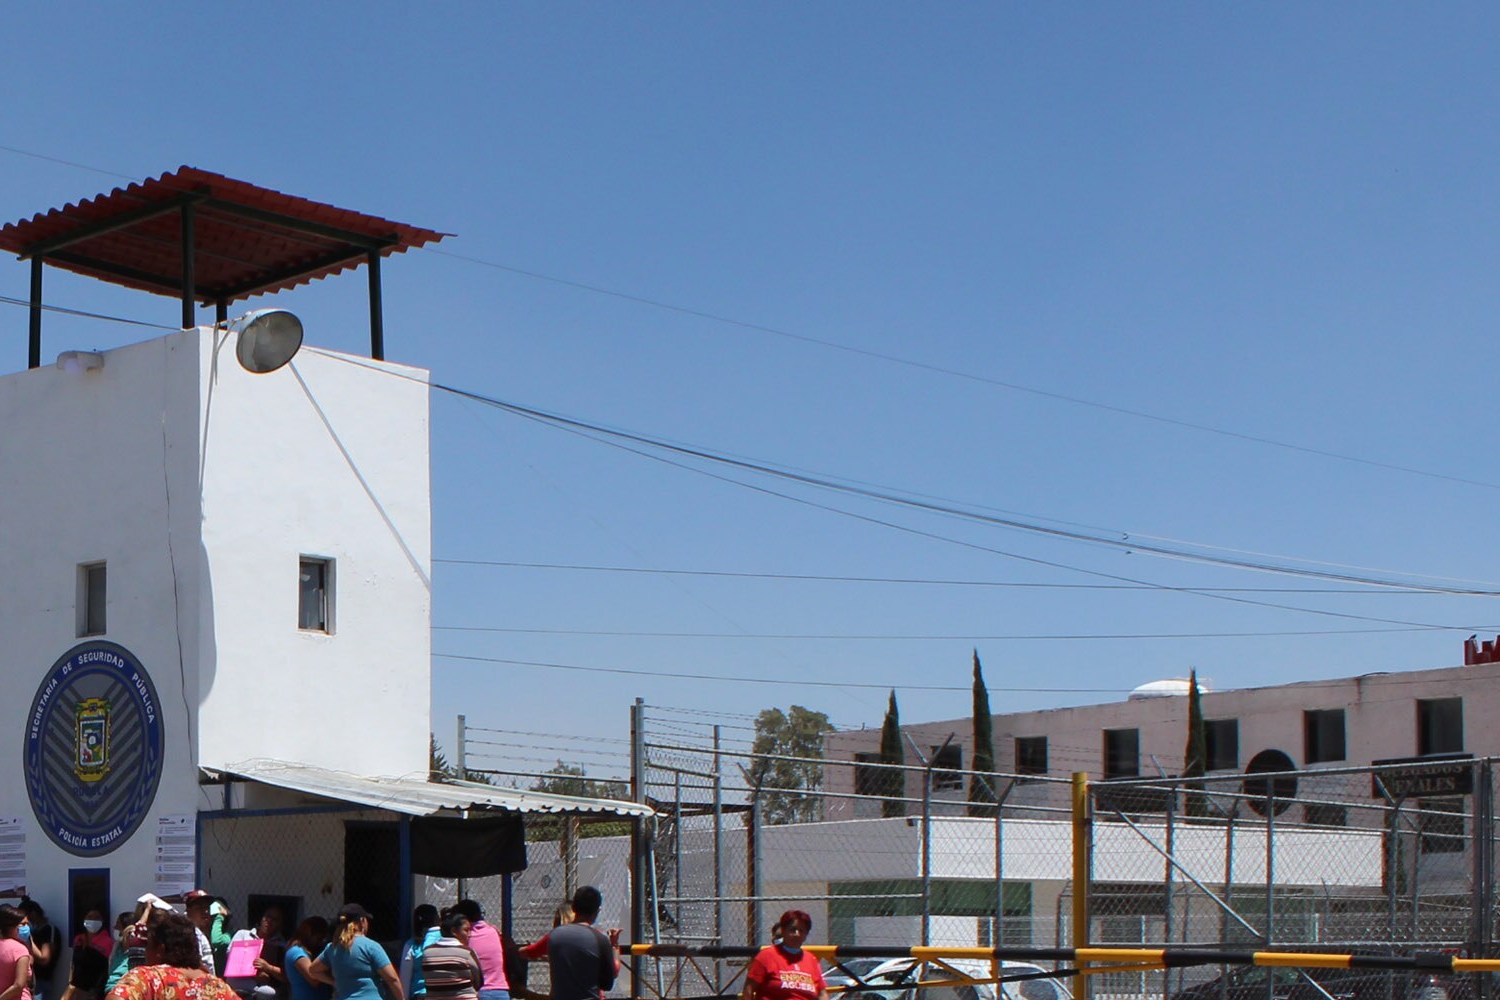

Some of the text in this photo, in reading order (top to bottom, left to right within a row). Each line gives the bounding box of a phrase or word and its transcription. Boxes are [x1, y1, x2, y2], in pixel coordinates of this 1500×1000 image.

[31, 651, 155, 739] SECRETARÍA DE SEGURIDAD PÚBLICA
[58, 825, 123, 848] POLICÍA ESTATAL
